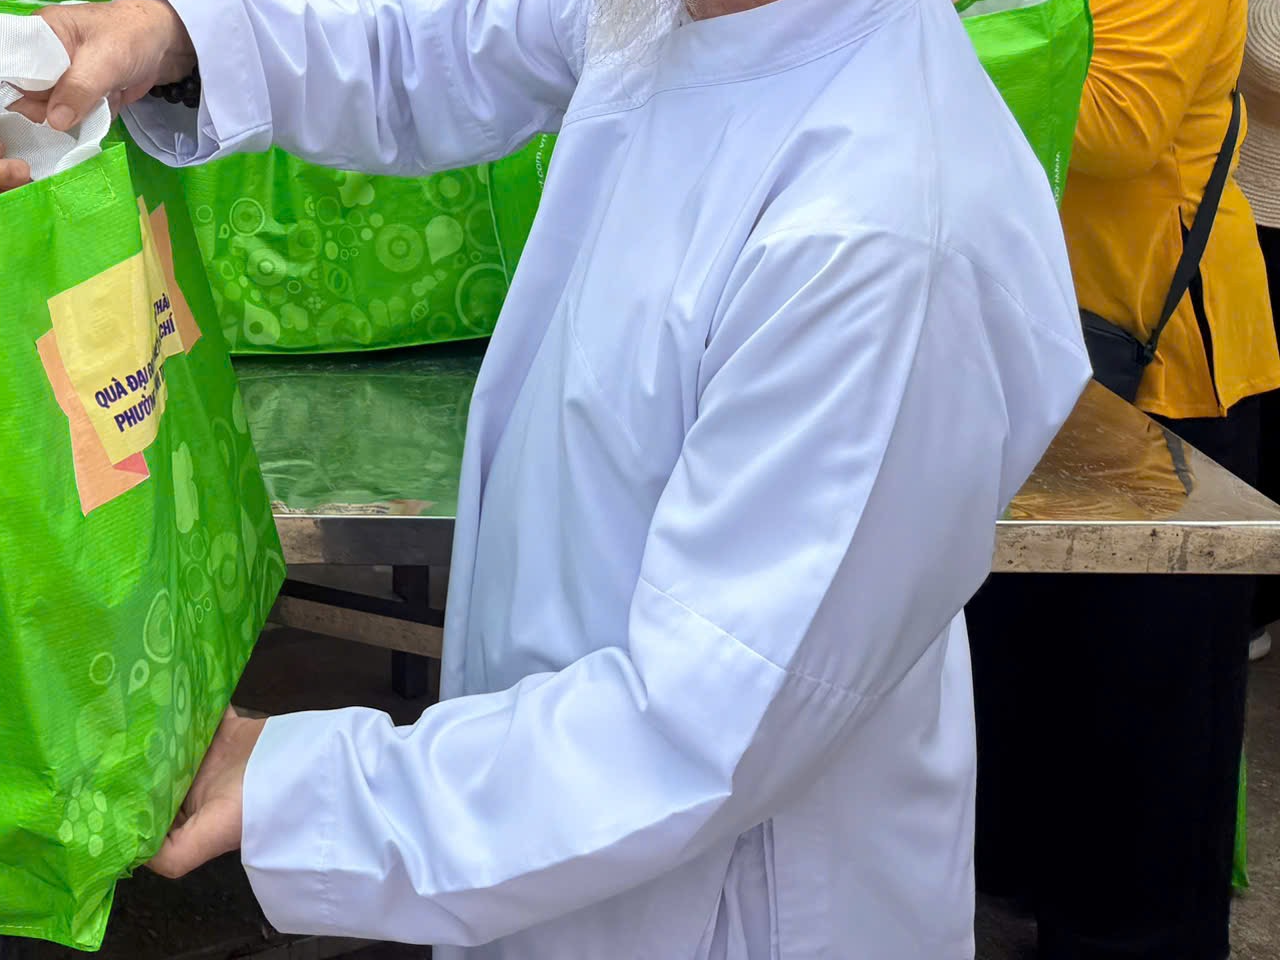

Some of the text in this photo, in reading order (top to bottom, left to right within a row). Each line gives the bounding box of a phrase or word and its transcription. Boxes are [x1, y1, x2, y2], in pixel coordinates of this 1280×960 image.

[94, 377, 128, 409] QUÀ
[125, 367, 149, 392] ĐẠI
[113, 394, 157, 433] PHƯỜN
